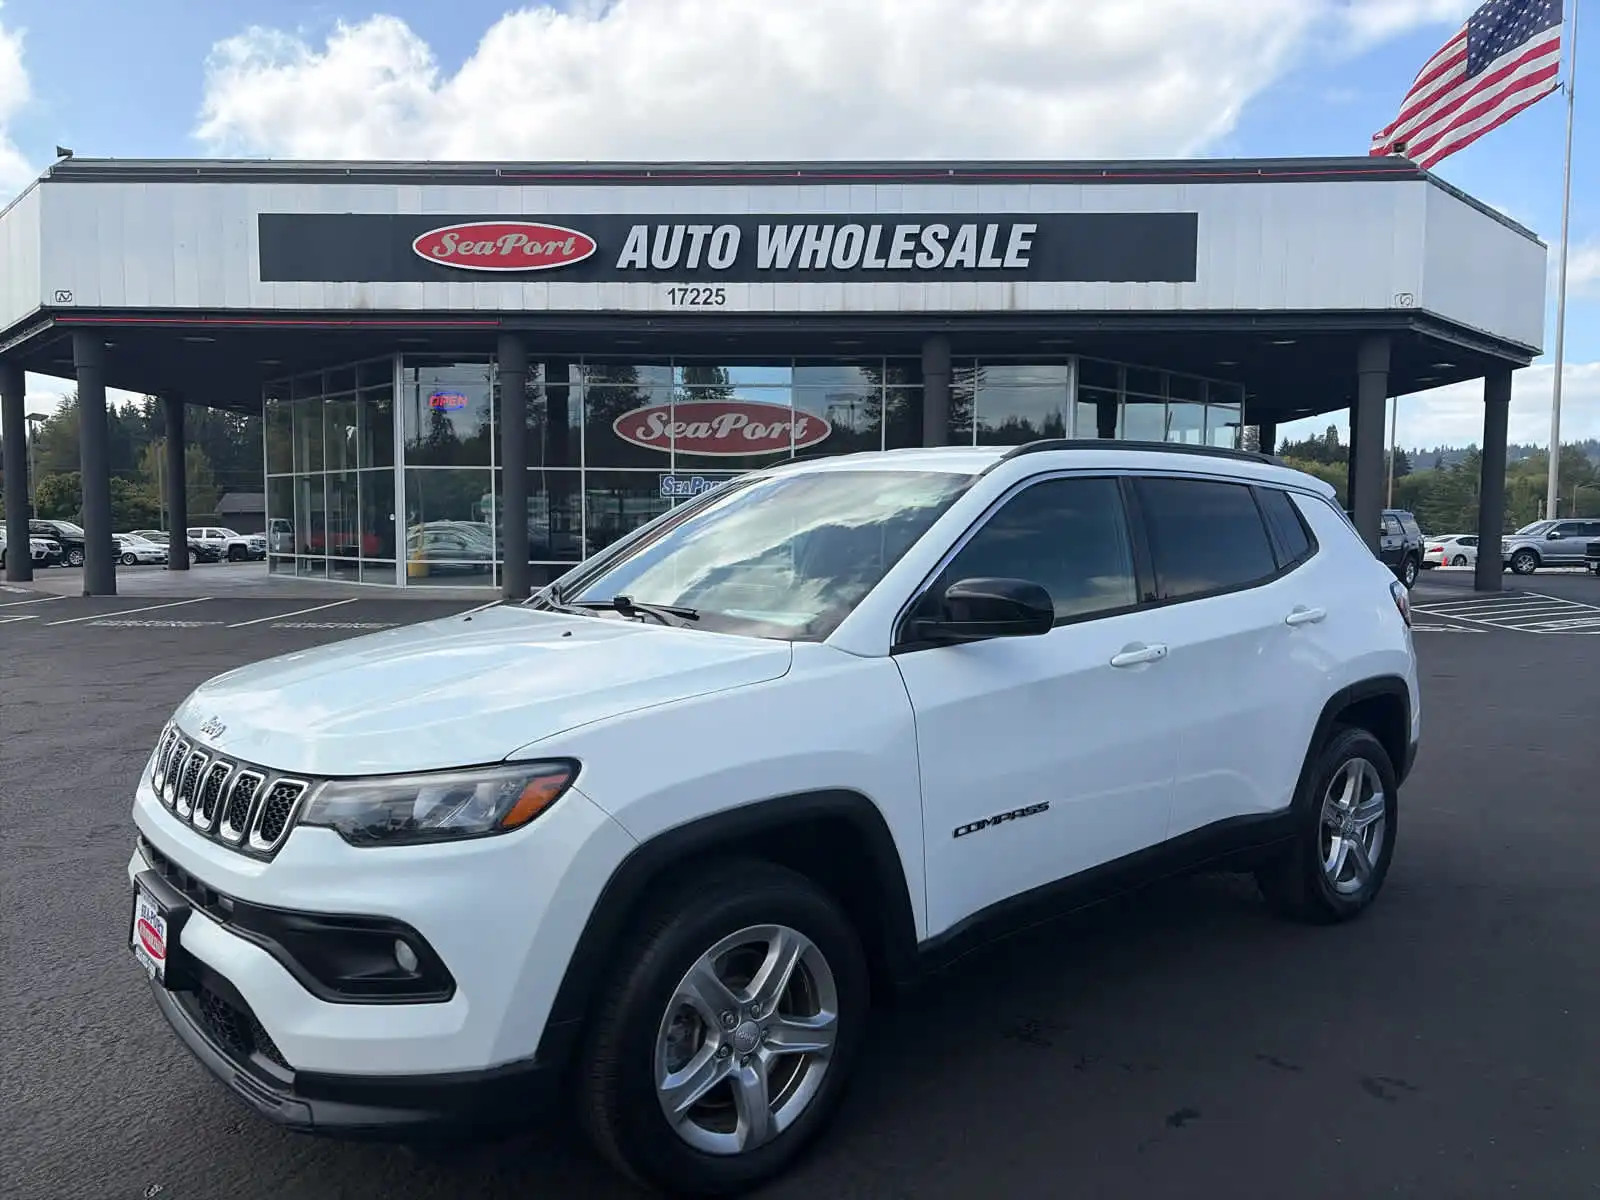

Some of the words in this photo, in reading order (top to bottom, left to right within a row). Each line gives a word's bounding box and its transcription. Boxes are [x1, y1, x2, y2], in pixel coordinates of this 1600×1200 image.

[431, 232, 576, 257] SeaPort
[616, 224, 741, 270] AUTO
[757, 223, 1038, 269] WHOLESALE
[667, 287, 726, 306] 17225
[636, 411, 809, 440] SeaPort
[953, 800, 1050, 838] COMPASS
